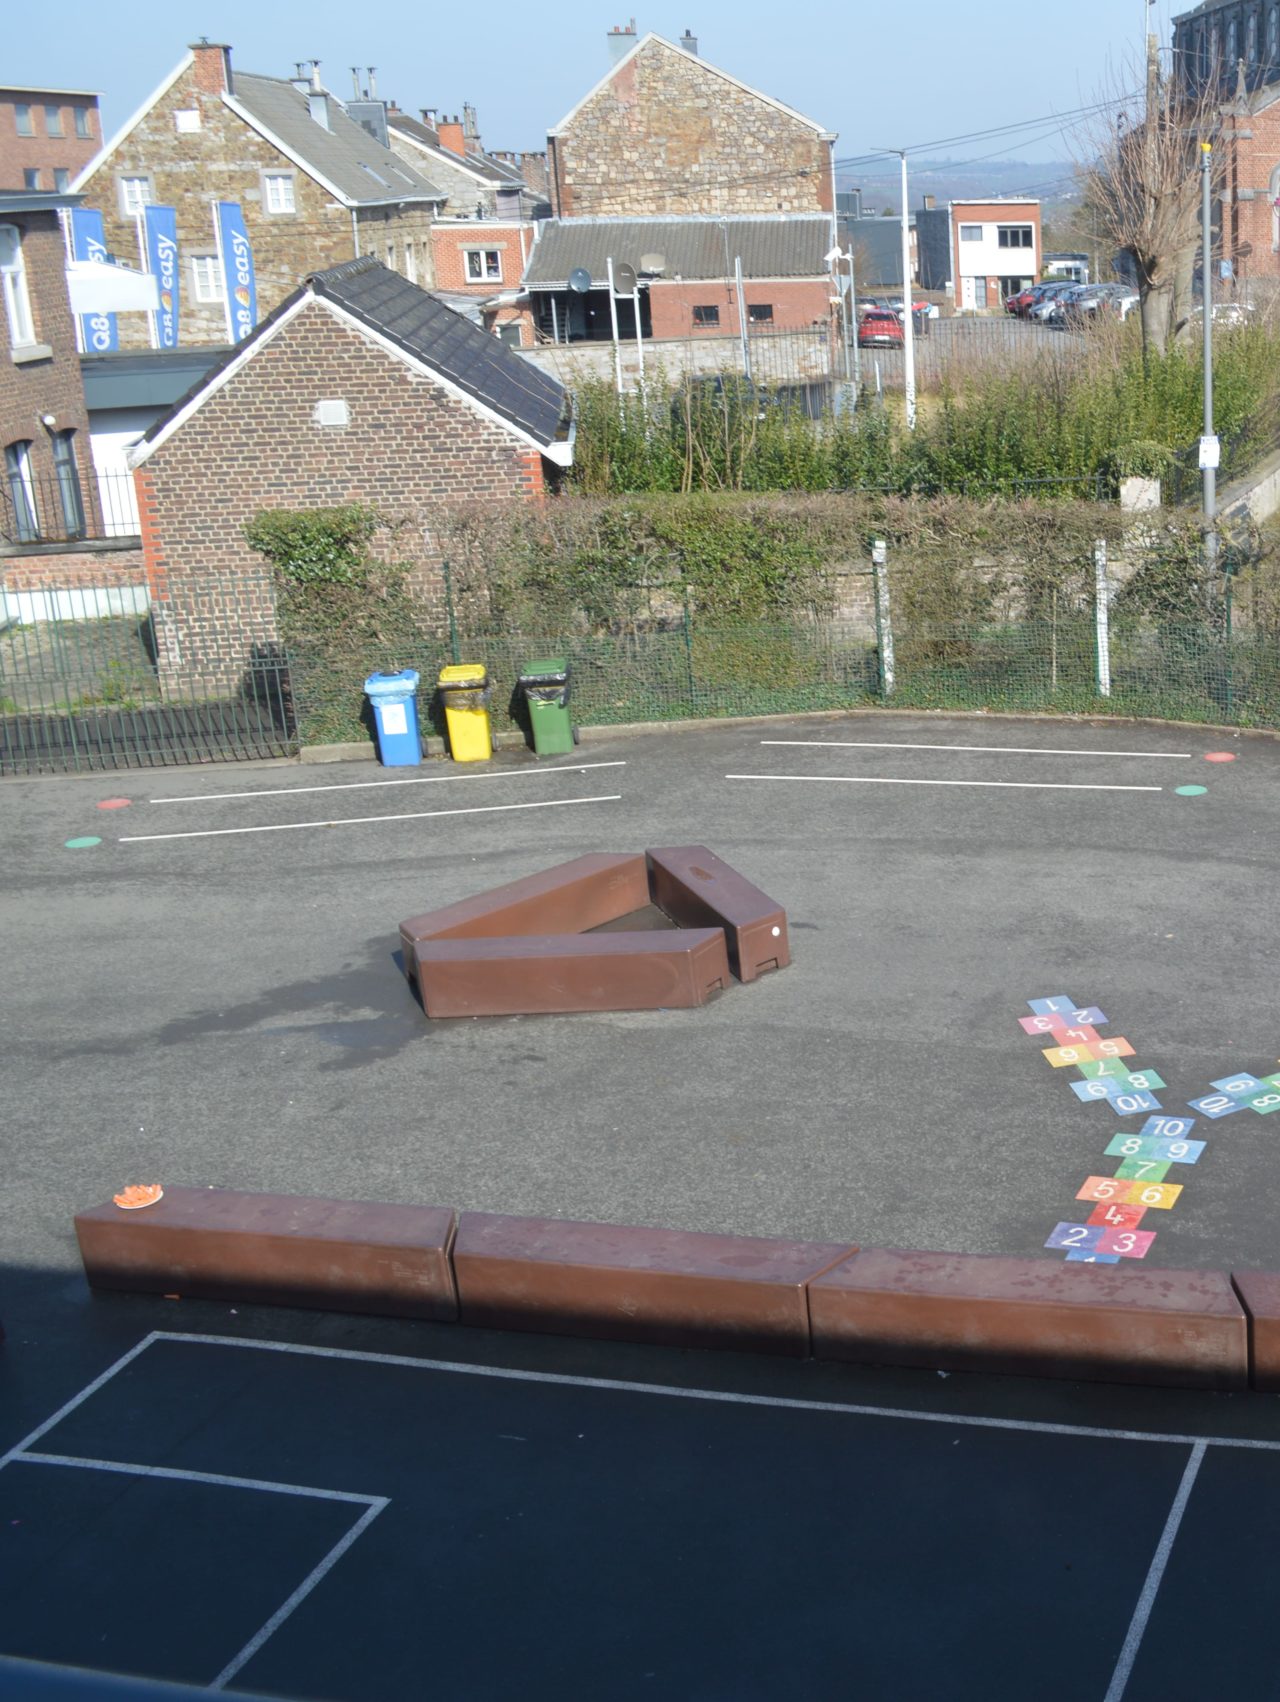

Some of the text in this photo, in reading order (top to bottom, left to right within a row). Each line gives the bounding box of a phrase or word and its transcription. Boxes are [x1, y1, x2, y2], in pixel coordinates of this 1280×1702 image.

[158, 234, 178, 290] easy
[231, 229, 250, 286] easy
[90, 314, 111, 350] Q8
[1046, 1000, 1059, 1012] 1
[1033, 1010, 1094, 1030] 2 3
[1066, 1030, 1088, 1040] 4
[1100, 1042, 1119, 1055] 5
[1097, 1061, 1115, 1076] 7
[1128, 1074, 1150, 1088] 8
[1116, 1094, 1150, 1110] 10
[1200, 1096, 1235, 1112] 10
[1153, 1120, 1185, 1136] 10
[1120, 1138, 1189, 1158] 8 9
[1134, 1161, 1157, 1178] 7
[1092, 1181, 1164, 1203] 5 6
[1104, 1206, 1124, 1224] 4
[1061, 1228, 1136, 1252] 2 3
